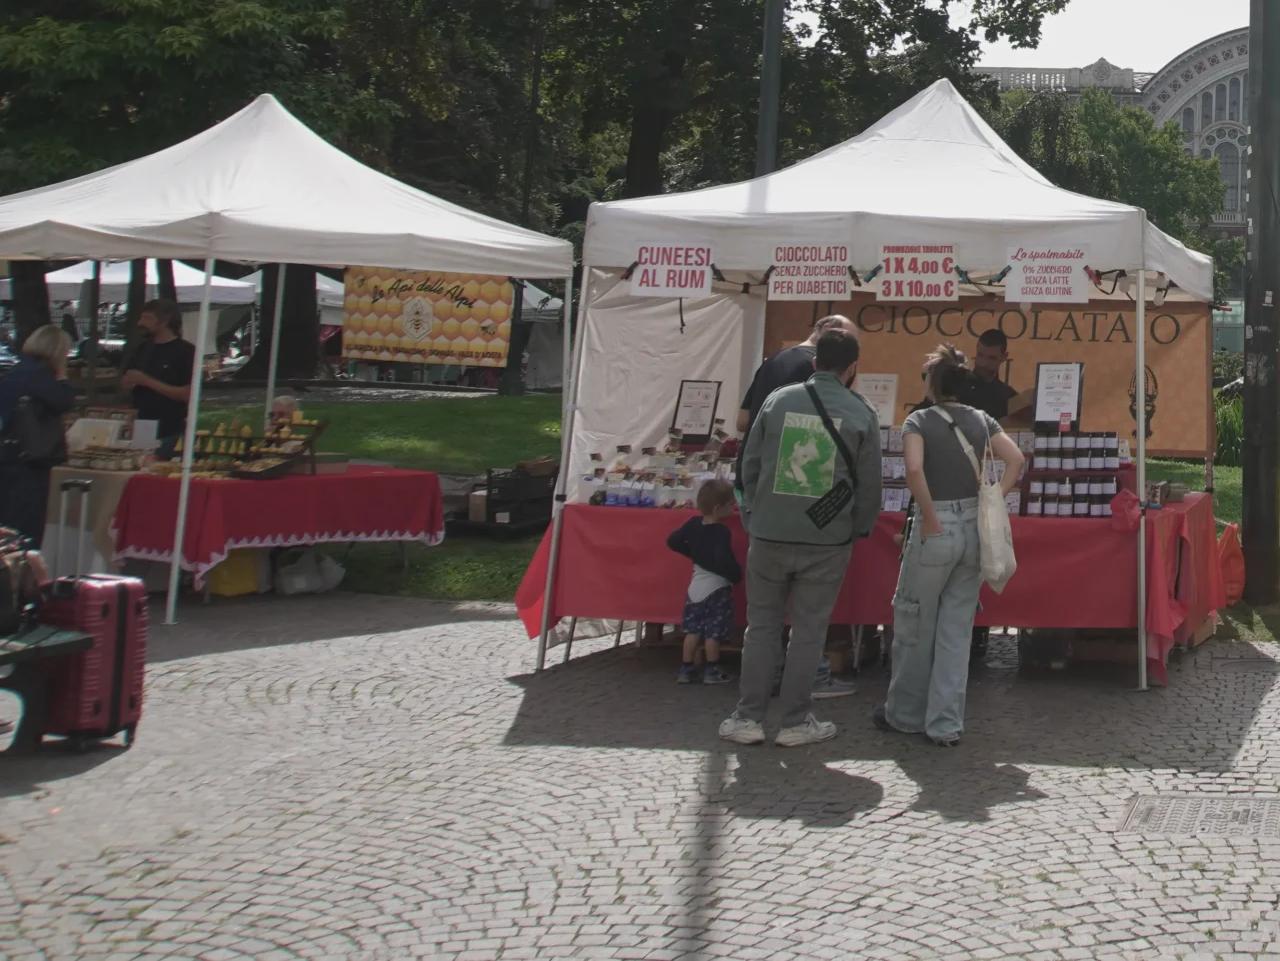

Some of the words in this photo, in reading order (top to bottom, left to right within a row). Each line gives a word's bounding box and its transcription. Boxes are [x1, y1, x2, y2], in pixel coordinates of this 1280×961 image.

[638, 246, 711, 266] CUNEESI
[775, 246, 847, 262] CIOCCOLATO
[883, 245, 922, 254] PROMOZIONE
[922, 245, 954, 254] TAVOLETTE
[1011, 247, 1028, 260] La
[1028, 248, 1084, 261] spalmabile
[774, 265, 801, 277] SENZA
[803, 265, 847, 277] ZUCCHERO
[882, 257, 892, 274] 1
[894, 257, 905, 274] X
[908, 257, 939, 276] 4,00
[941, 257, 954, 274] €
[1022, 265, 1036, 274] 0%
[1036, 265, 1073, 274] ZUCCHERO
[639, 270, 660, 288] AL
[666, 271, 705, 289] RUM
[1025, 276, 1047, 285] SENZA
[1049, 276, 1070, 285] LATTE
[388, 278, 416, 300] Api
[416, 277, 445, 295] delle
[444, 285, 476, 309] Alpi
[774, 280, 793, 295] PER
[796, 280, 847, 295] DIABETICI
[882, 280, 892, 298] 3
[894, 280, 904, 297] X
[906, 280, 941, 298] 10,00
[943, 279, 954, 297] €
[1021, 287, 1043, 296] SENZA
[1045, 287, 1073, 296] GLUTINE
[857, 304, 1180, 345] CIOCCOLATAO
